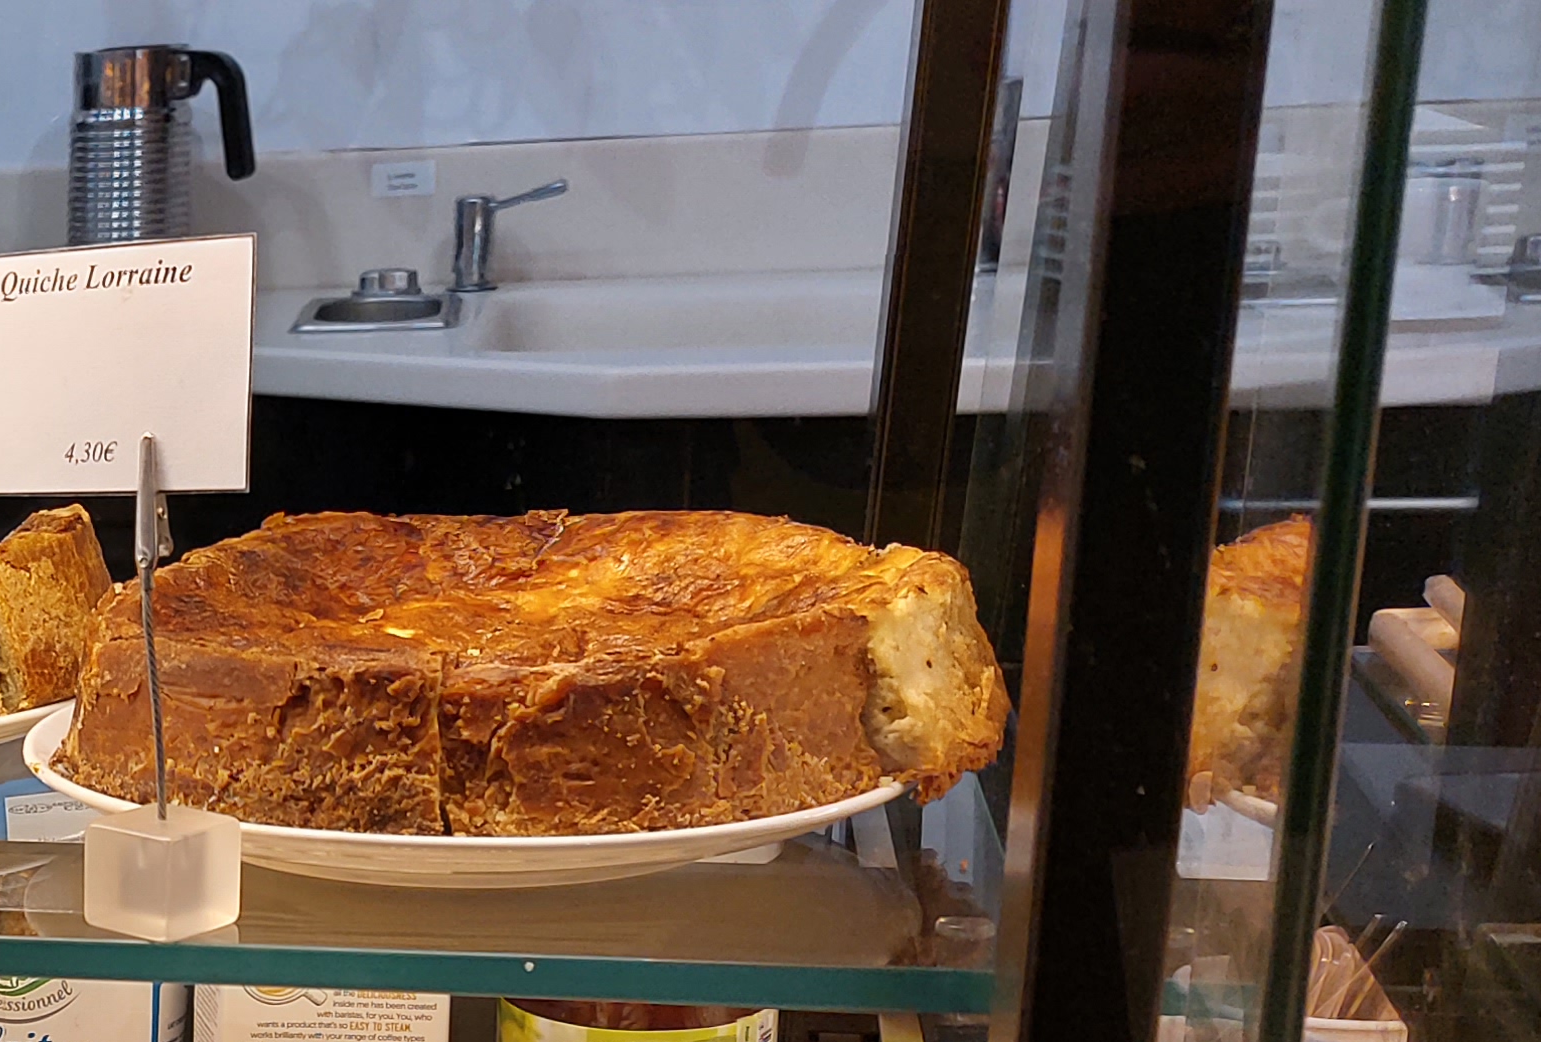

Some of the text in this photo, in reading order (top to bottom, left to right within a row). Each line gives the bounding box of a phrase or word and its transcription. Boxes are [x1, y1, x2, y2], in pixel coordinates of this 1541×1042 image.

[1, 259, 193, 302] Quiche Lorraine
[65, 441, 118, 466] 4,30€
[349, 1022, 369, 1031] EASY
[373, 1022, 382, 1032] TO
